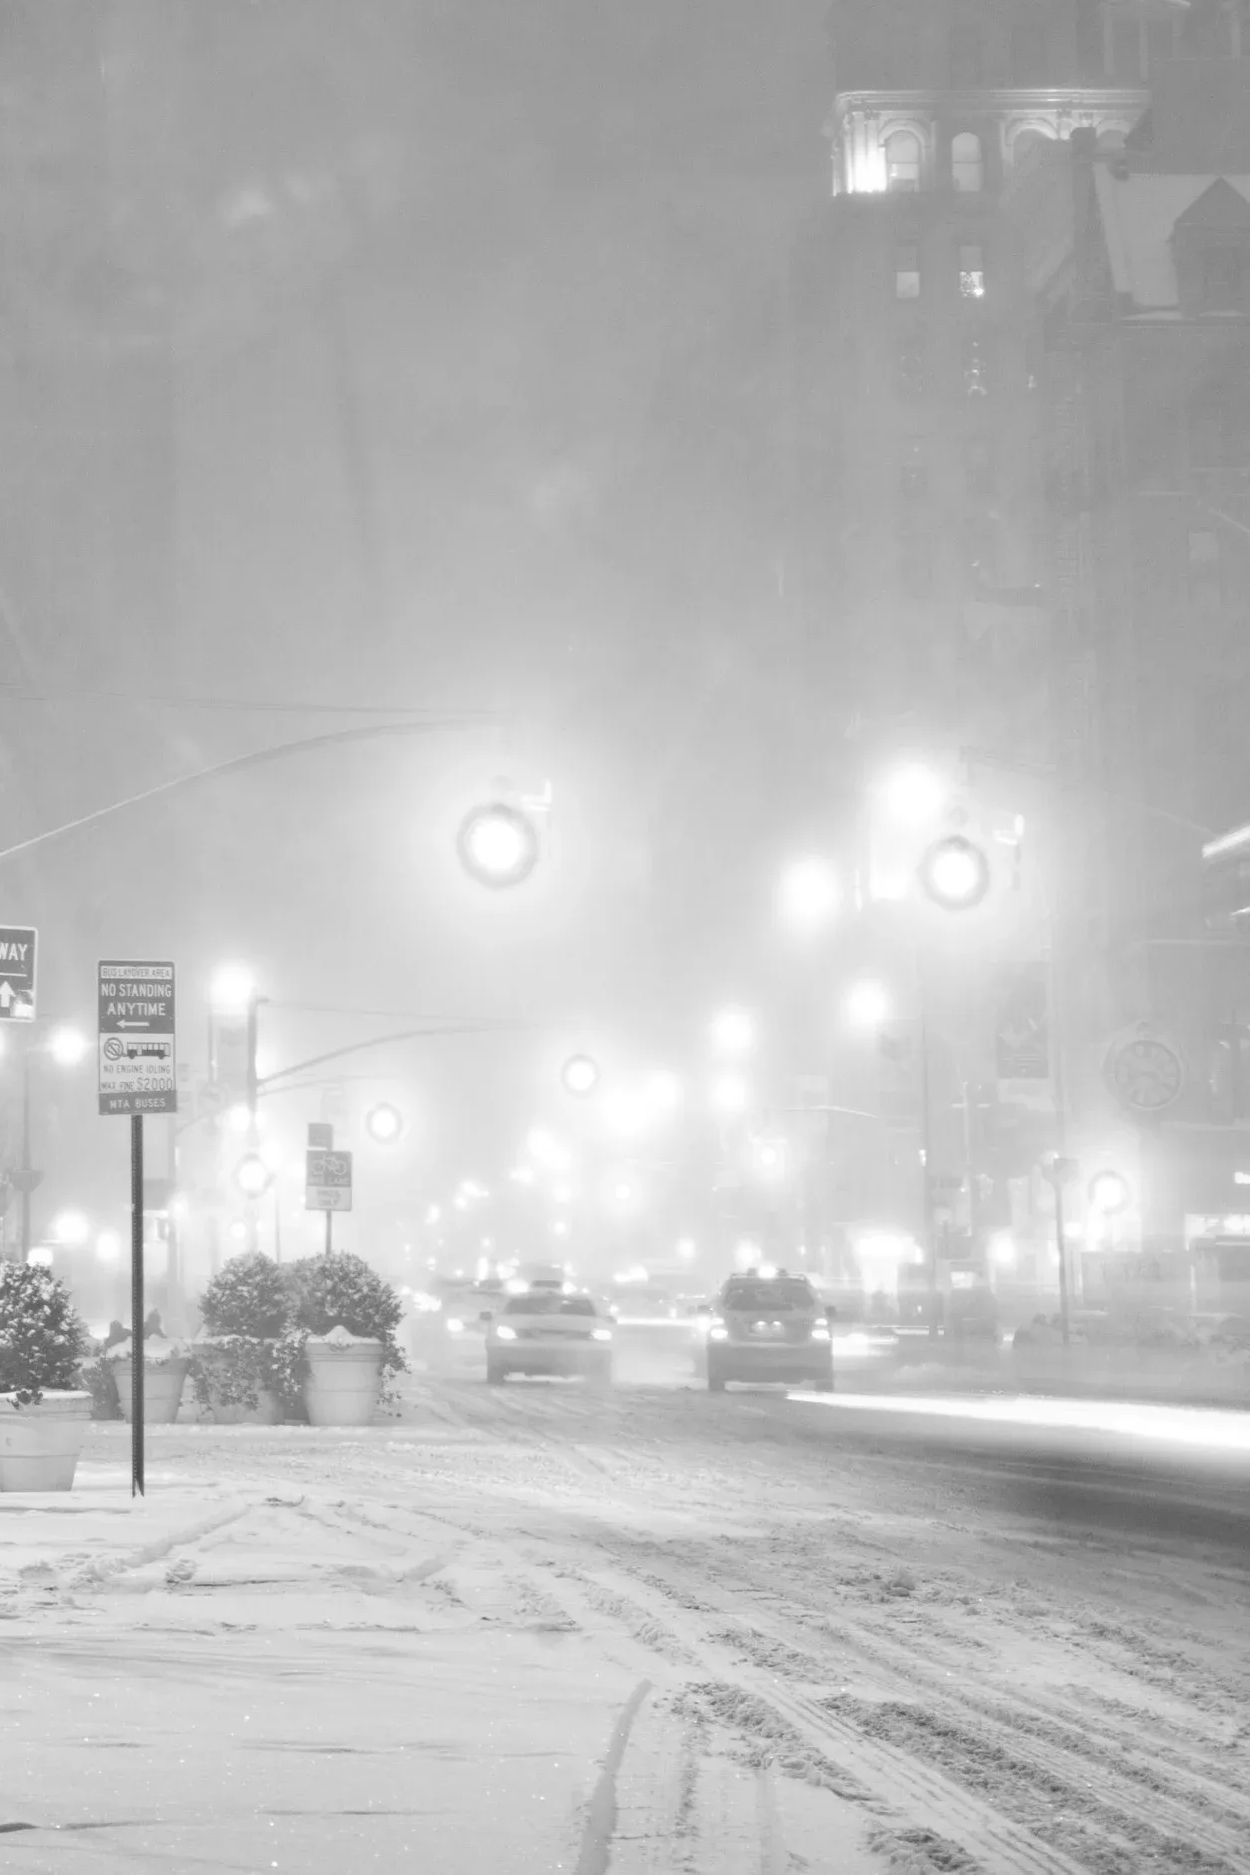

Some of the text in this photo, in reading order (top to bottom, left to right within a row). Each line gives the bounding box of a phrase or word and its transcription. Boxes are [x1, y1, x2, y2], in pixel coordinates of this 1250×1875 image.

[102, 967, 170, 978] BUS LAYOVER AREA
[101, 983, 172, 997] NO STANDING
[107, 1002, 166, 1016] ANYTIME
[103, 1064, 171, 1074] NO ENGINE IDLING
[101, 1077, 173, 1091] MAX FINE $2000
[109, 1097, 166, 1110] MTA BUSES
